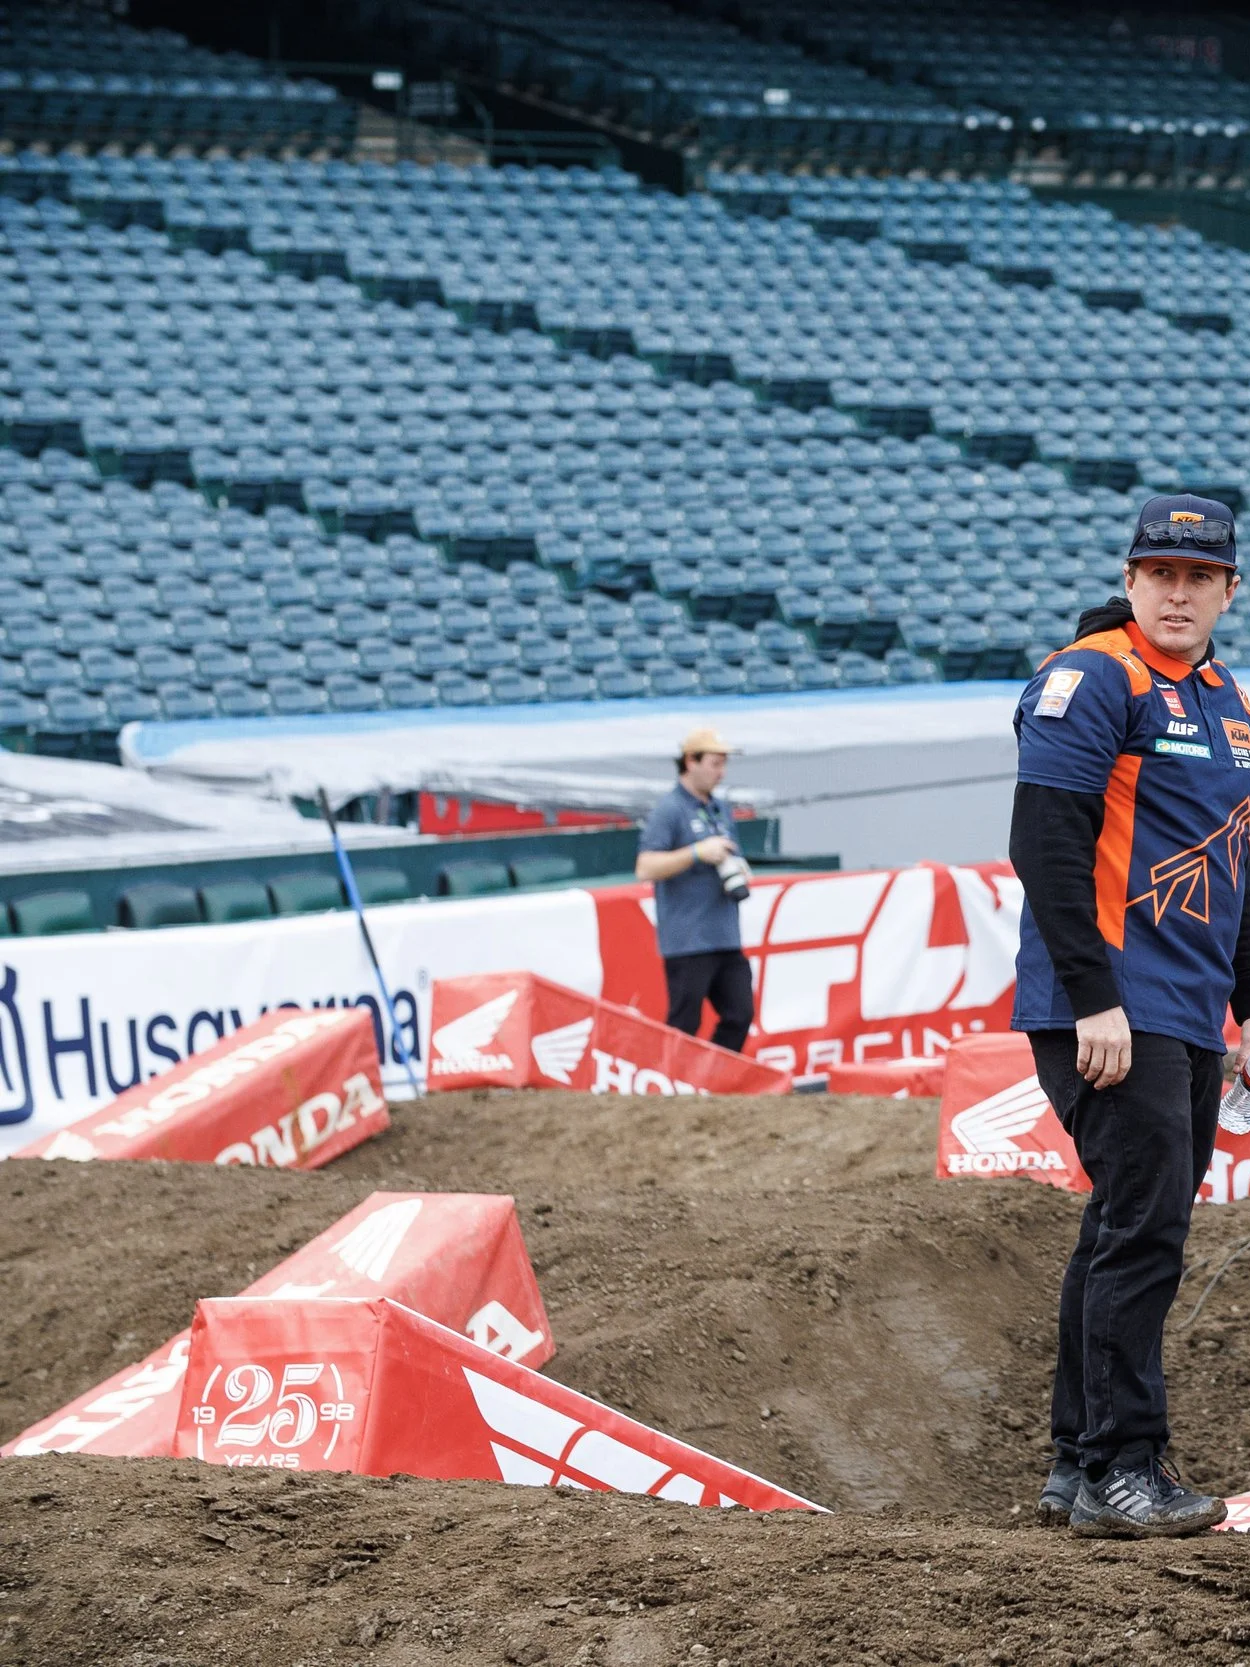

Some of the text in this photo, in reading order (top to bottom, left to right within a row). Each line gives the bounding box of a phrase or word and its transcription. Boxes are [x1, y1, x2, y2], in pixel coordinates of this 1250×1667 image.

[1166, 721, 1198, 736] WP
[1230, 727, 1250, 743] KTM
[1170, 742, 1210, 759] MOTOREX
[432, 1056, 515, 1076] HONDA
[948, 1150, 1066, 1174] HONDA
[192, 1362, 356, 1449] 19 25 98
